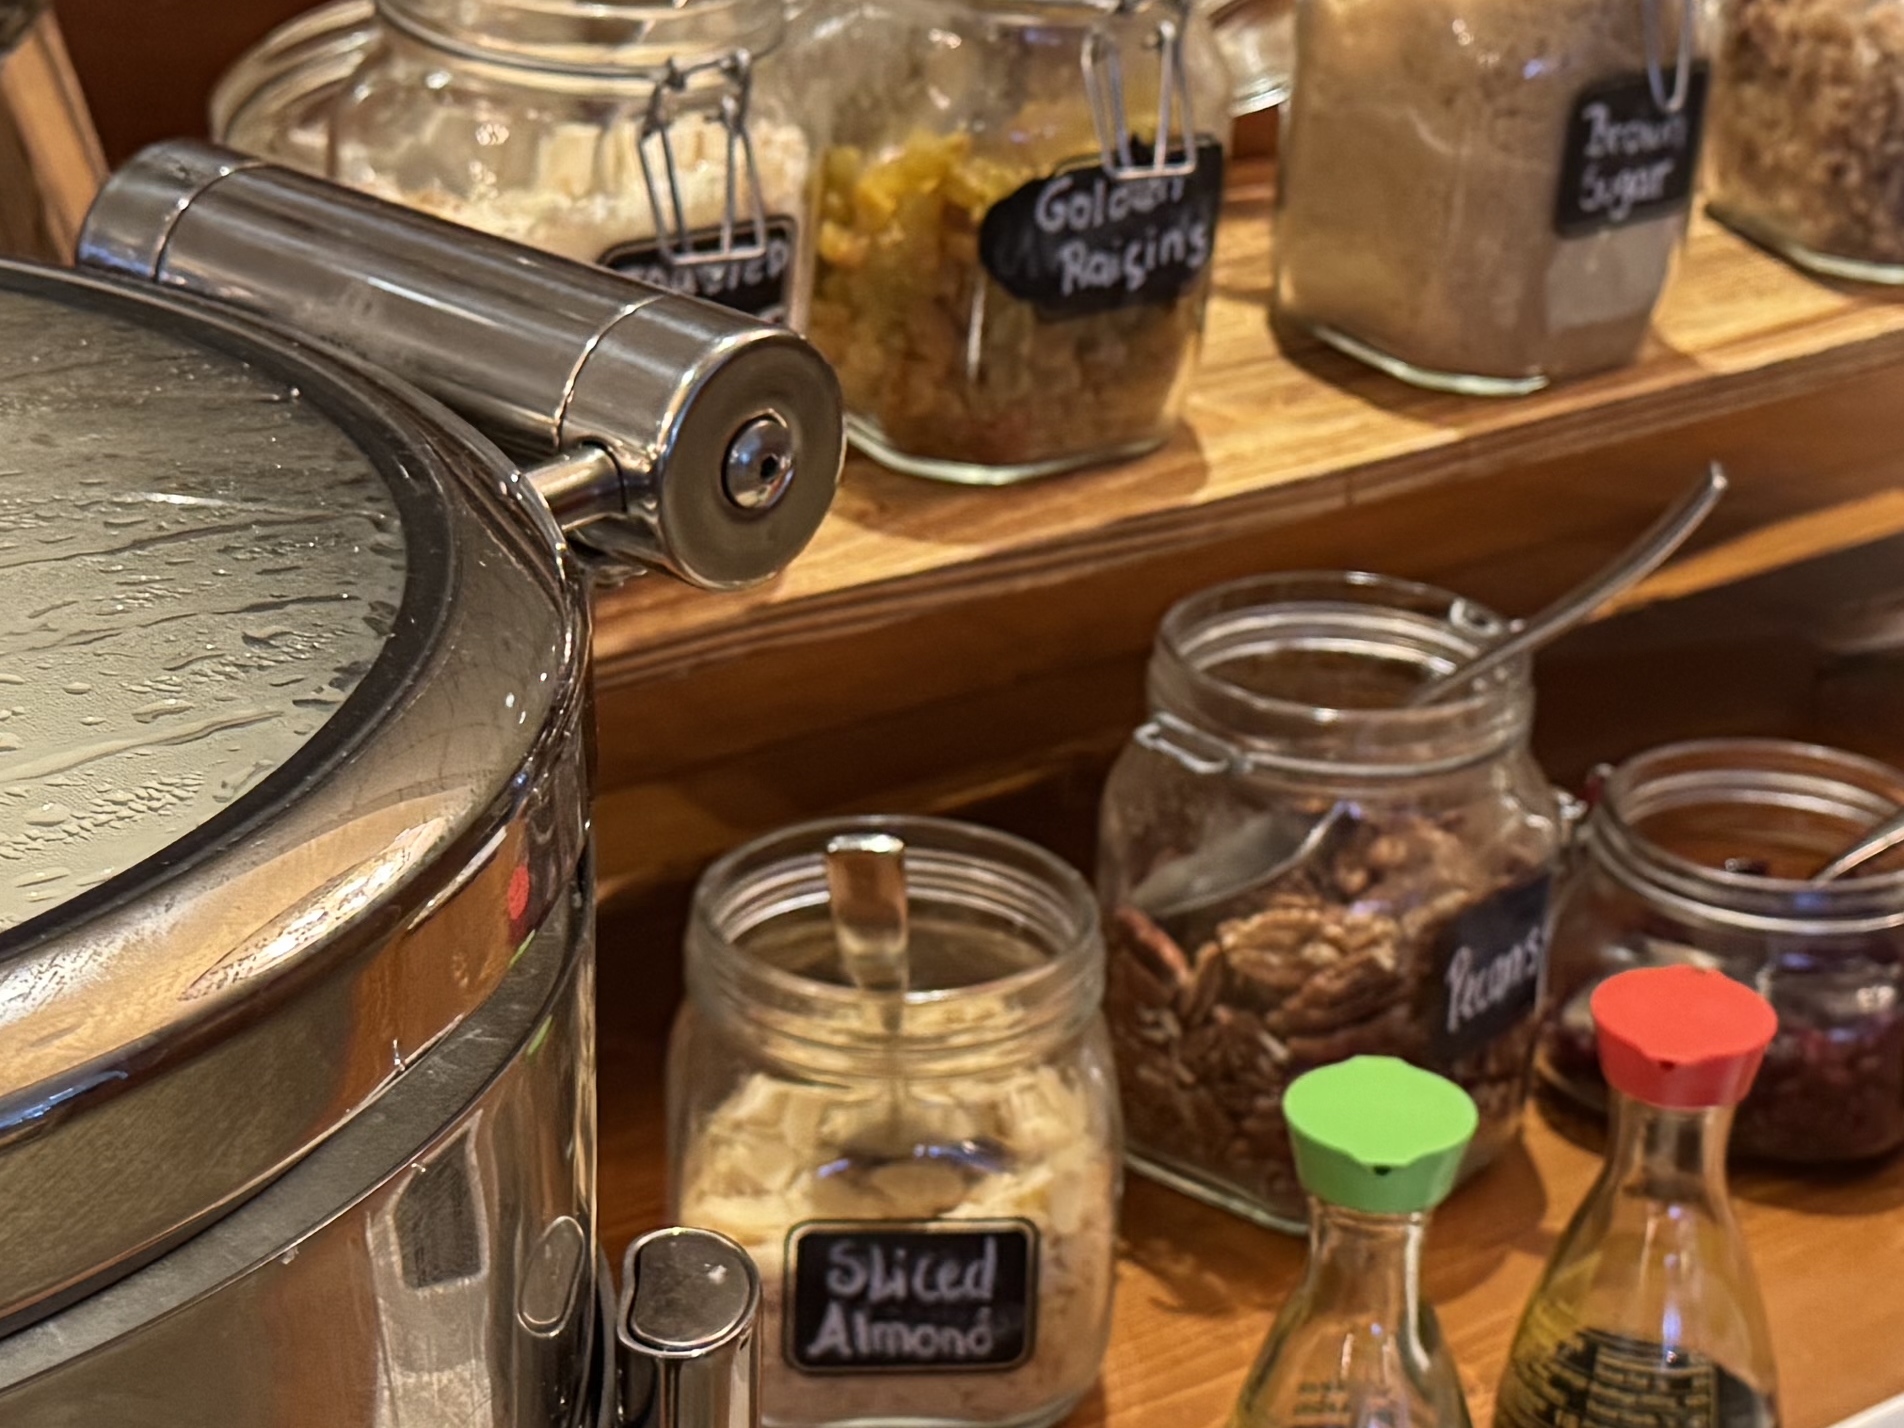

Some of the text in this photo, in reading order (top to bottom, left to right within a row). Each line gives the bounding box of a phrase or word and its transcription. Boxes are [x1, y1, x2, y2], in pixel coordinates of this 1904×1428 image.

[1058, 223, 1209, 298] Raisins
[825, 1236, 997, 1301] Sliced
[805, 1304, 994, 1358] Almond
